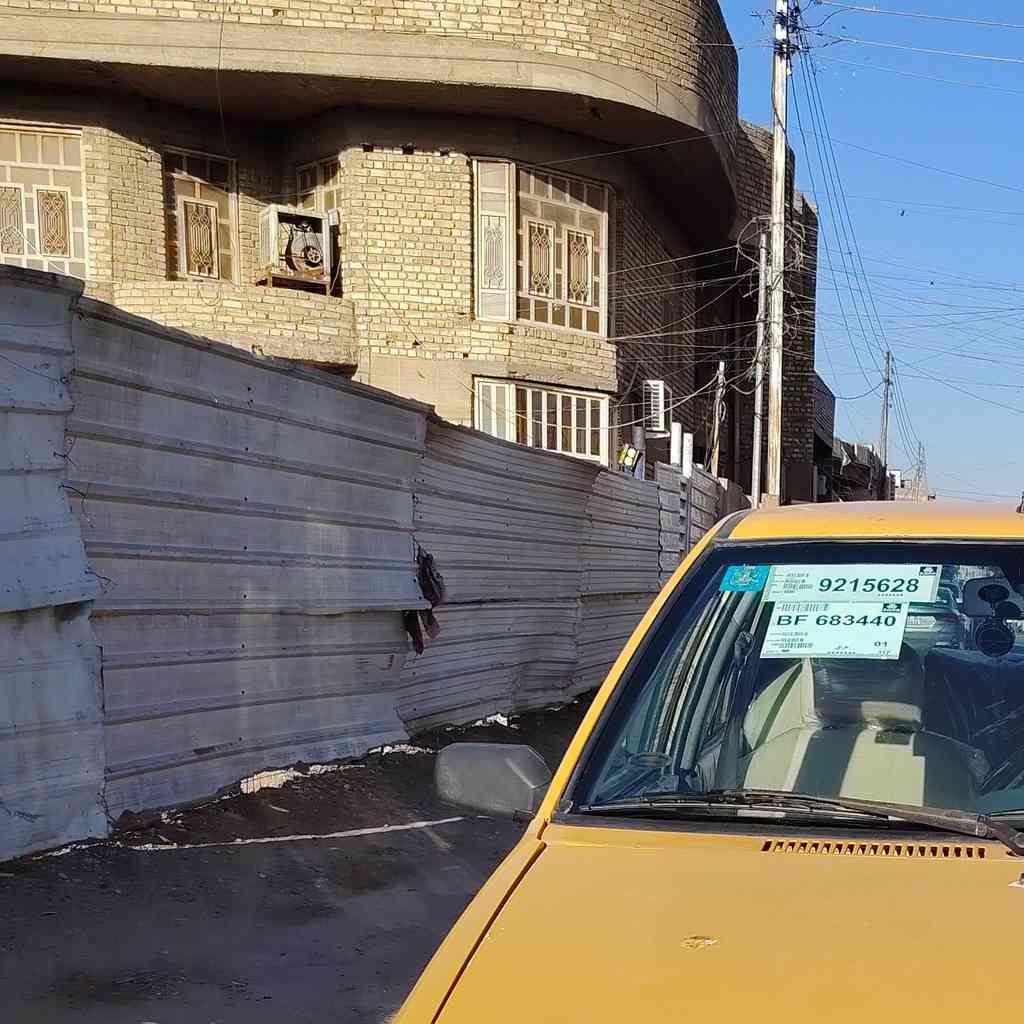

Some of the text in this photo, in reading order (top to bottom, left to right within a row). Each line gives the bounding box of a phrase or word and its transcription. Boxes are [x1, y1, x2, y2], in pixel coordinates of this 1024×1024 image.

[818, 578, 919, 593] 9215628
[777, 615, 896, 627] BF 683440
